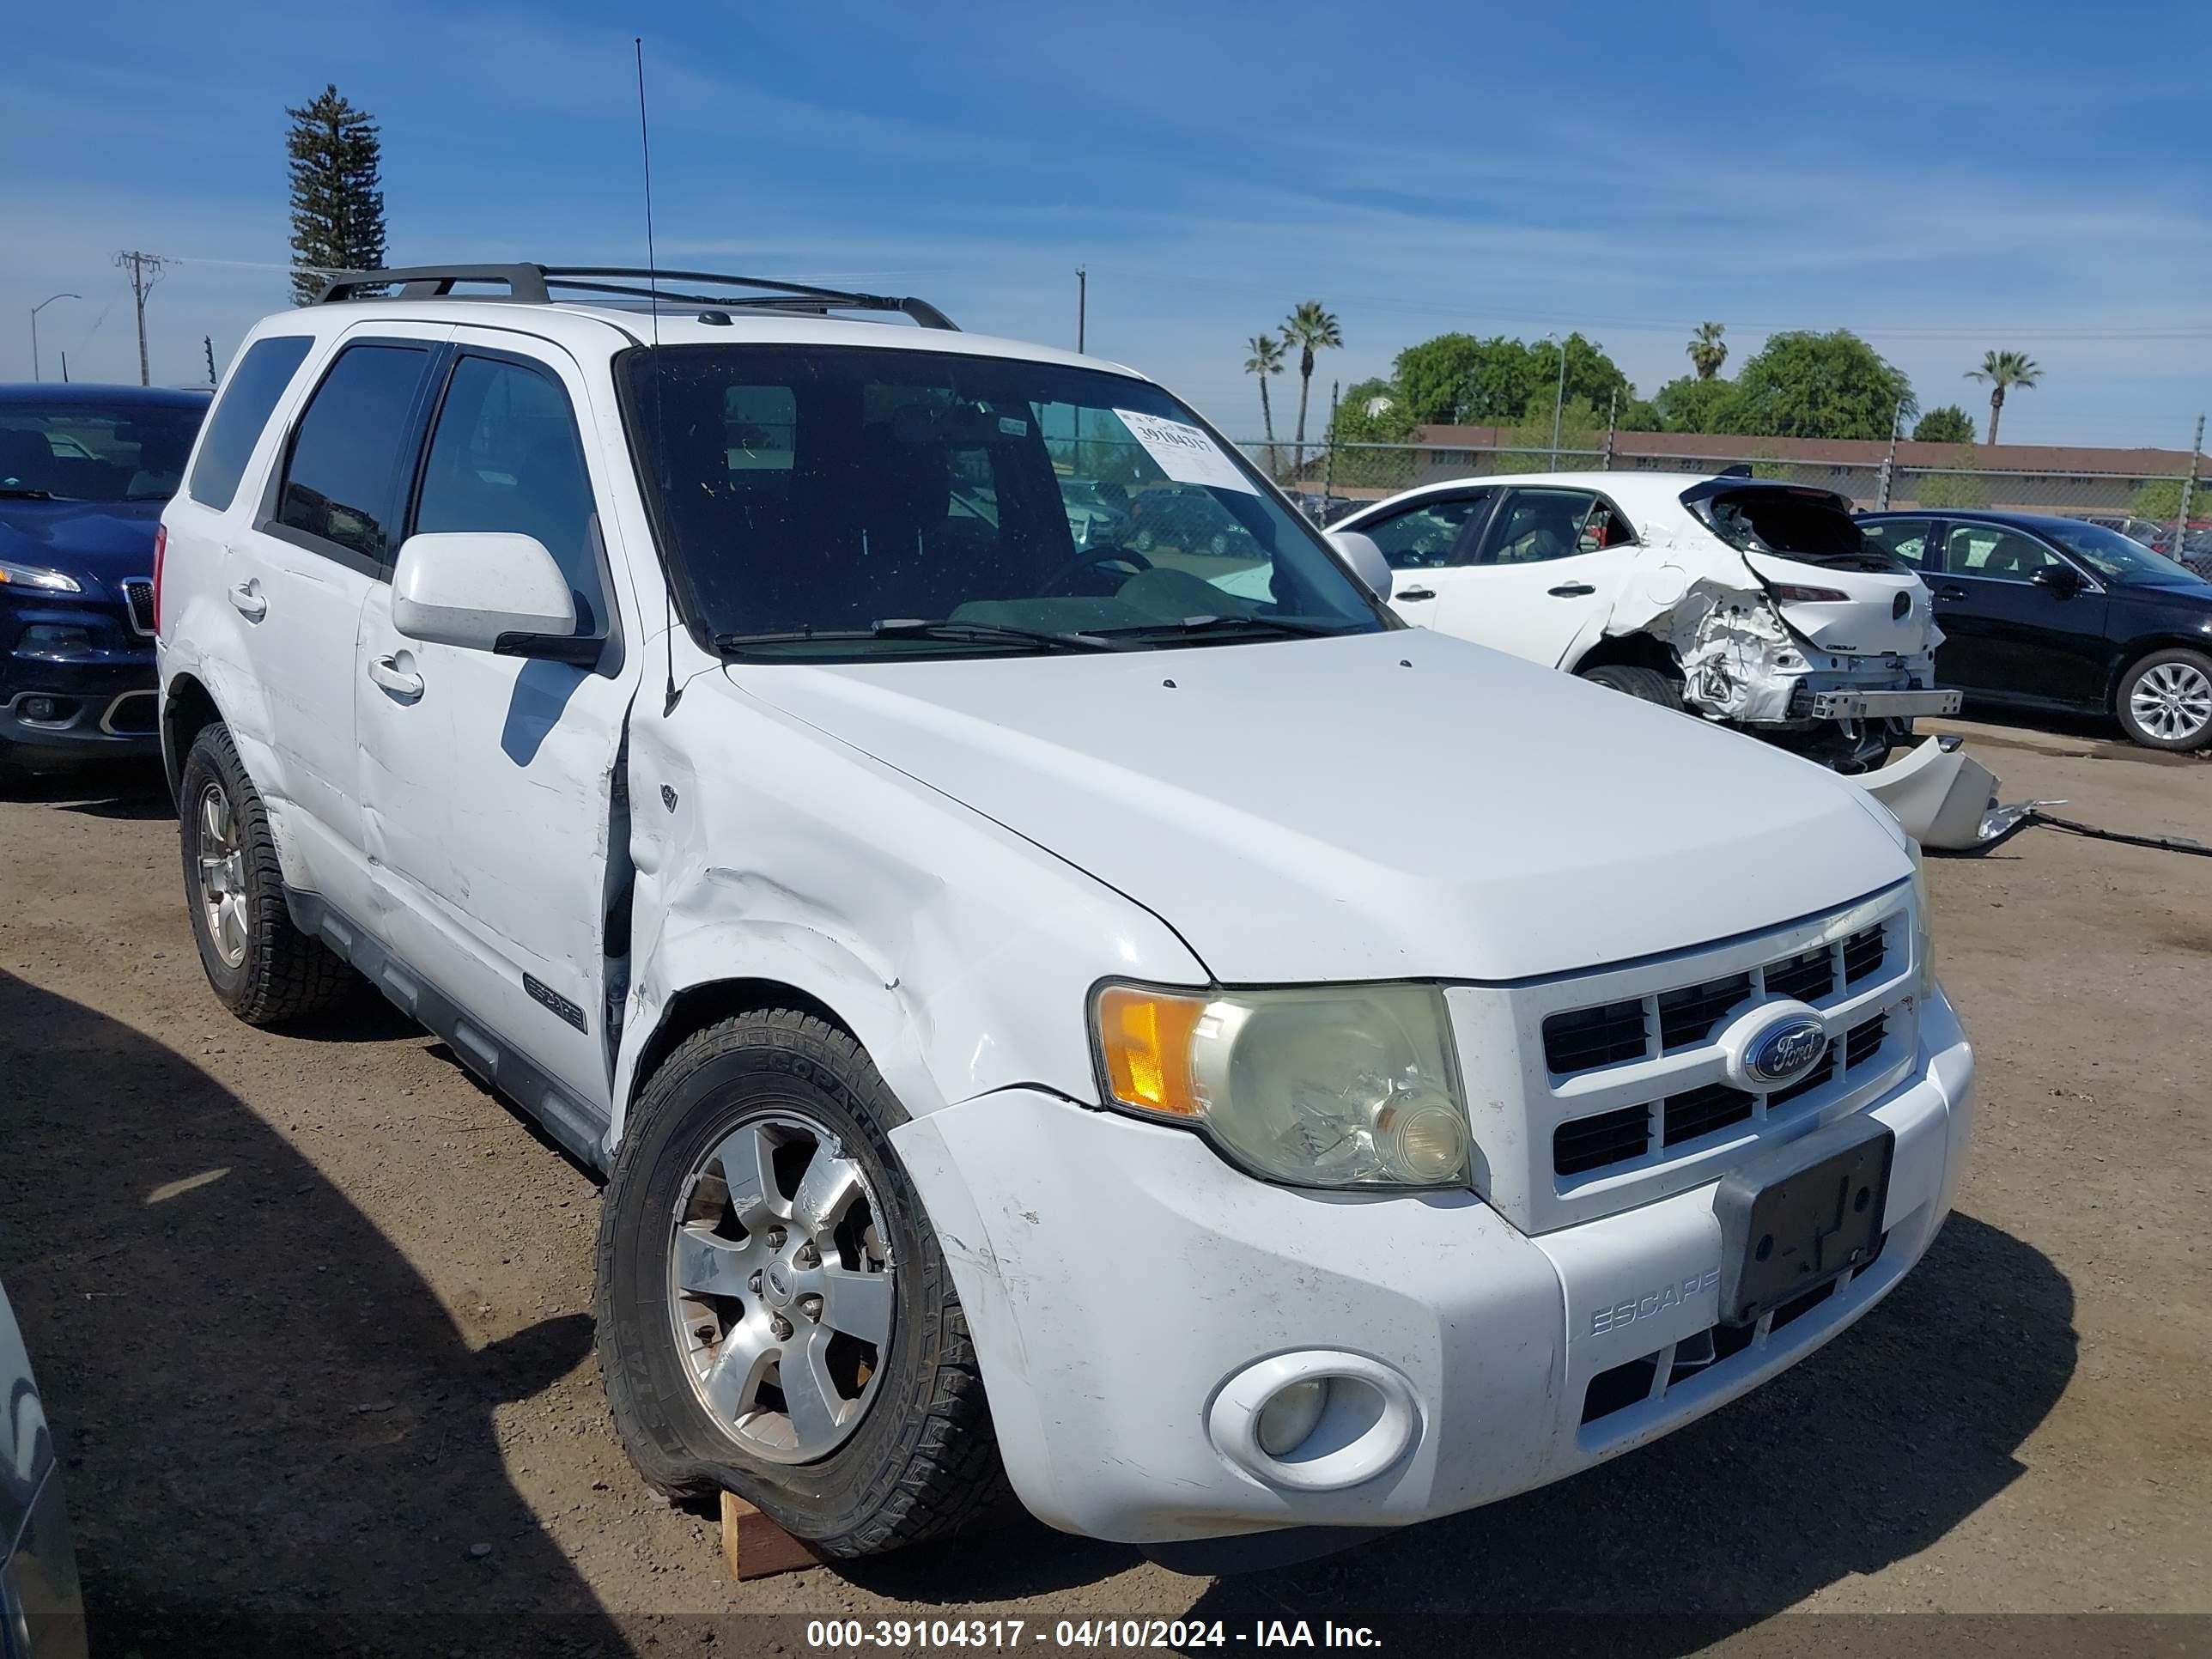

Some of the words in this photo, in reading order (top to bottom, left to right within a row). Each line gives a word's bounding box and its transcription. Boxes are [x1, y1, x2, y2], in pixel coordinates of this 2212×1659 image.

[1136, 426, 1212, 453] 39104317
[1773, 1027, 1818, 1072] Ford
[1591, 1268, 1720, 1337] ESCAPE
